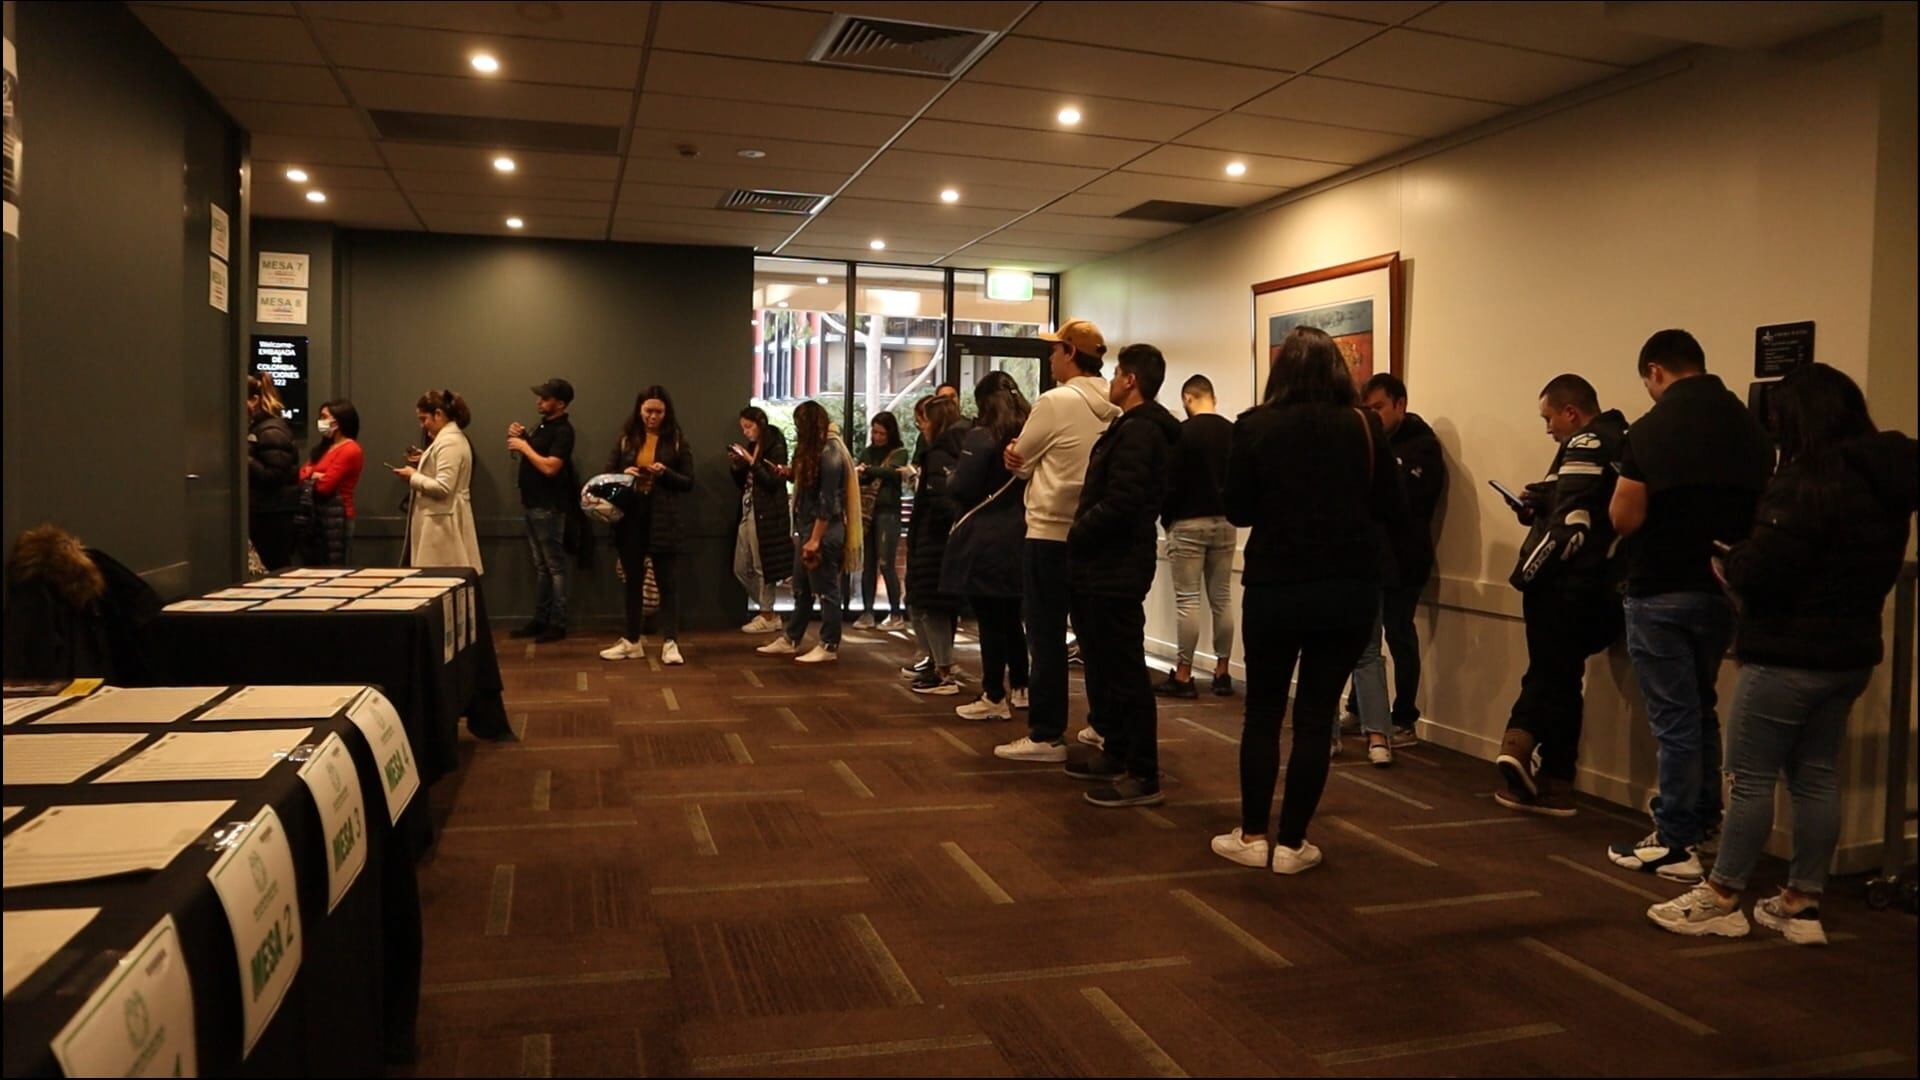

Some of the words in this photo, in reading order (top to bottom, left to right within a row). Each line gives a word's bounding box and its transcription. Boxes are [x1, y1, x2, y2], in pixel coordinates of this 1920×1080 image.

[262, 260, 294, 270] MESA
[260, 297, 292, 306] MESA
[384, 749, 406, 794] MESA
[332, 815, 355, 872] MESA
[353, 807, 361, 839] 3
[251, 919, 284, 1003] MESA
[283, 903, 294, 948] 2
